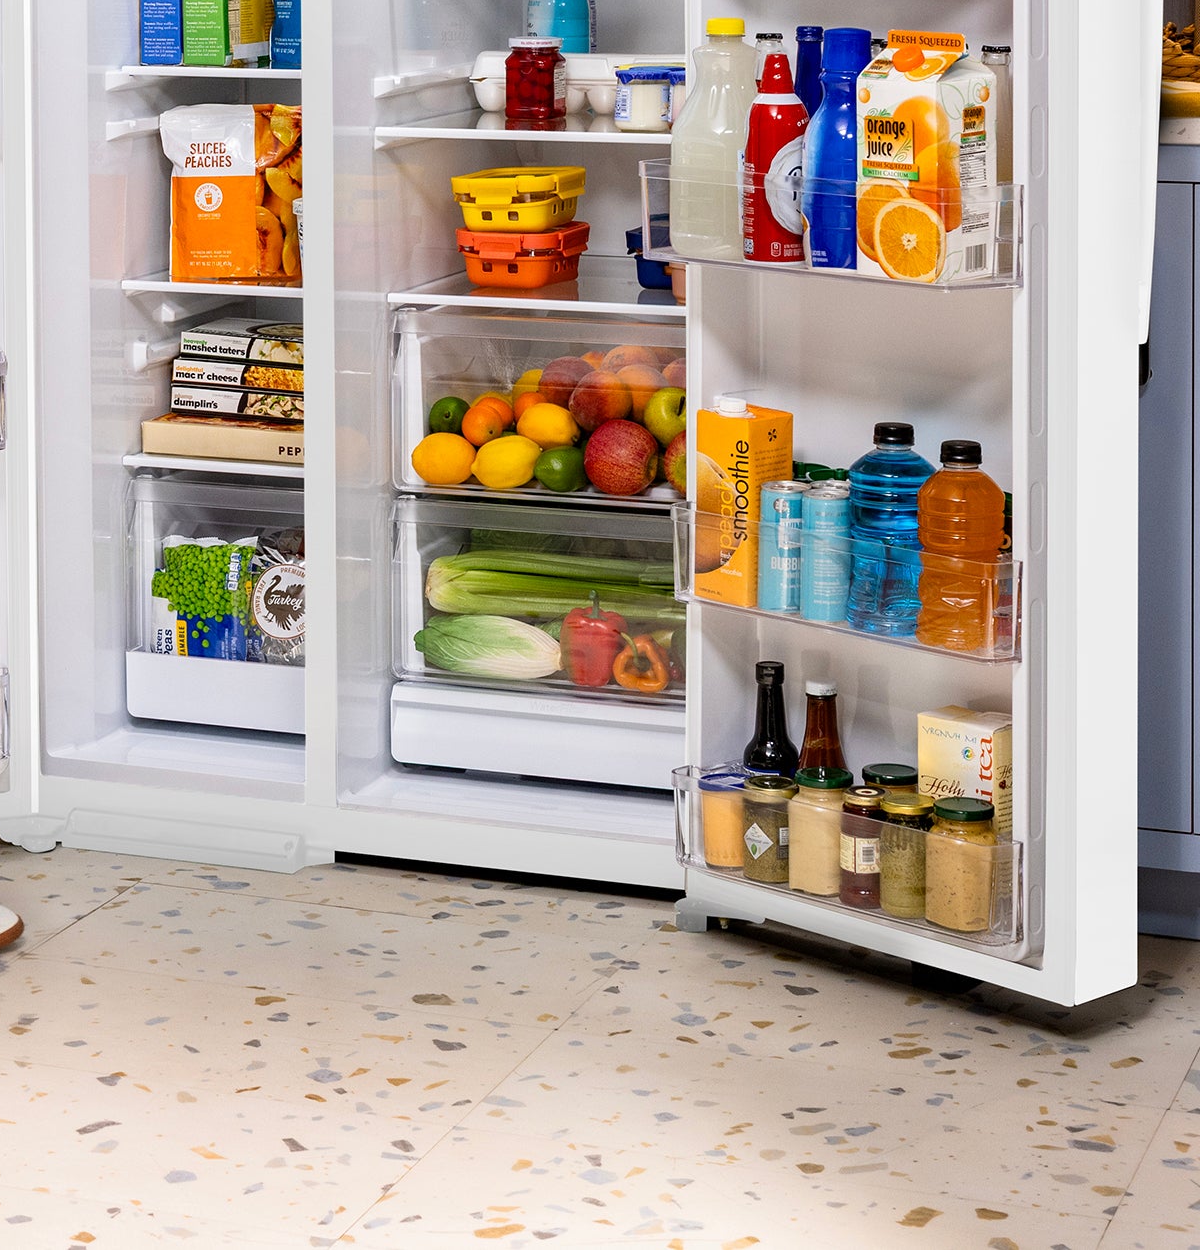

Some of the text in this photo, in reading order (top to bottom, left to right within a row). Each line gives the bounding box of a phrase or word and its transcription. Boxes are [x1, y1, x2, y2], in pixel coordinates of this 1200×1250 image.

[891, 33, 962, 48] FRESH SQUEEZED
[963, 107, 982, 119] orange
[867, 118, 906, 139] orange
[962, 120, 976, 132] juice
[190, 142, 226, 155] SLICED
[866, 135, 893, 159] juice
[184, 155, 232, 168] PEACHES
[867, 160, 913, 170] FRESH SQUEEZED
[883, 170, 909, 178] CALCIUM
[183, 343, 246, 356] mashed taters
[175, 371, 196, 380] mac
[206, 371, 238, 383] cheese
[173, 398, 219, 410] dumplin's
[727, 440, 749, 541] smoothie
[714, 479, 733, 551] peach
[267, 594, 304, 611] Turkey
[979, 736, 993, 781] tea
[919, 774, 966, 797] Holly
